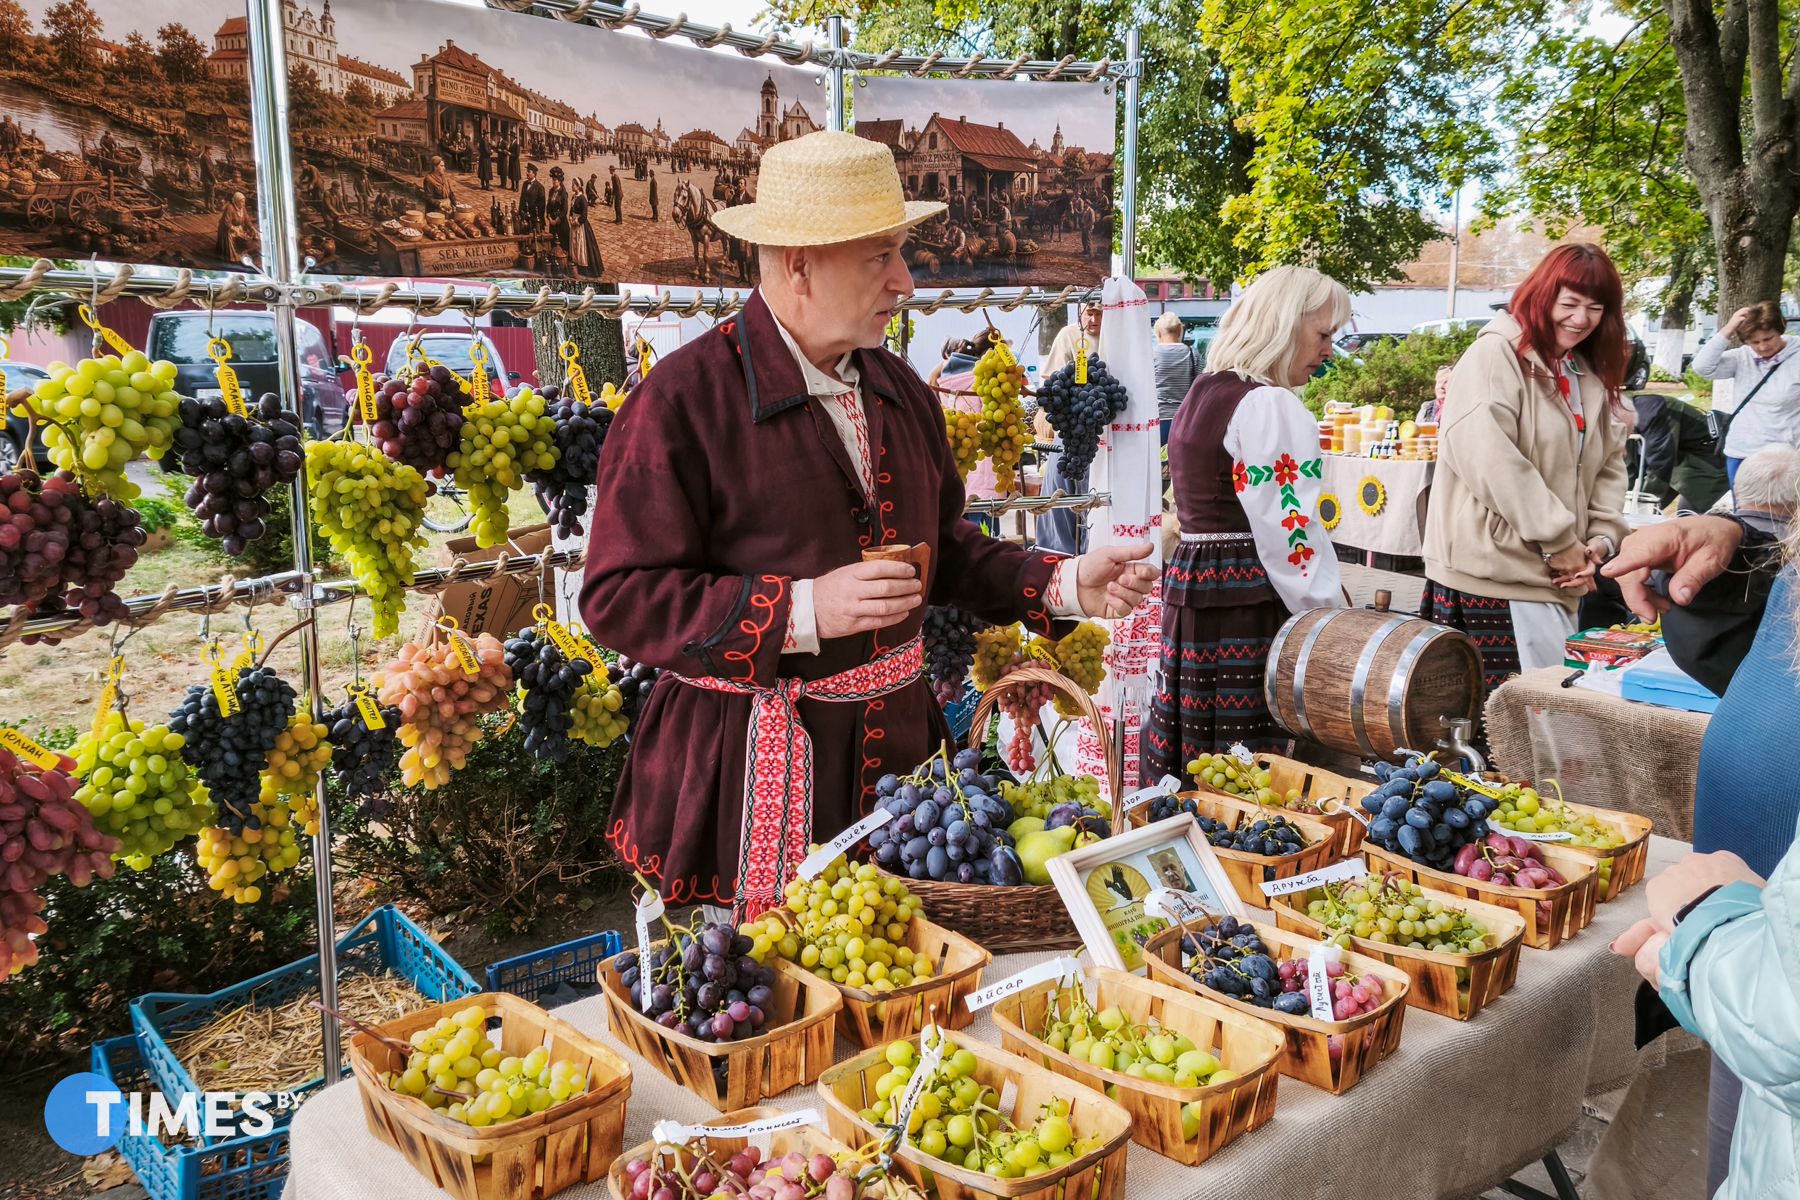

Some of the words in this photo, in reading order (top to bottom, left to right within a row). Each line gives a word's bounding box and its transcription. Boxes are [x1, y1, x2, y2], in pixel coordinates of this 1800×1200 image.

[440, 79, 458, 91] WINO
[438, 248, 459, 259] SER
[431, 263, 455, 272] WINO
[462, 591, 477, 632] АДОВЫЙ
[3, 731, 44, 759] ЮЛИАН
[1272, 874, 1320, 893] Дружба
